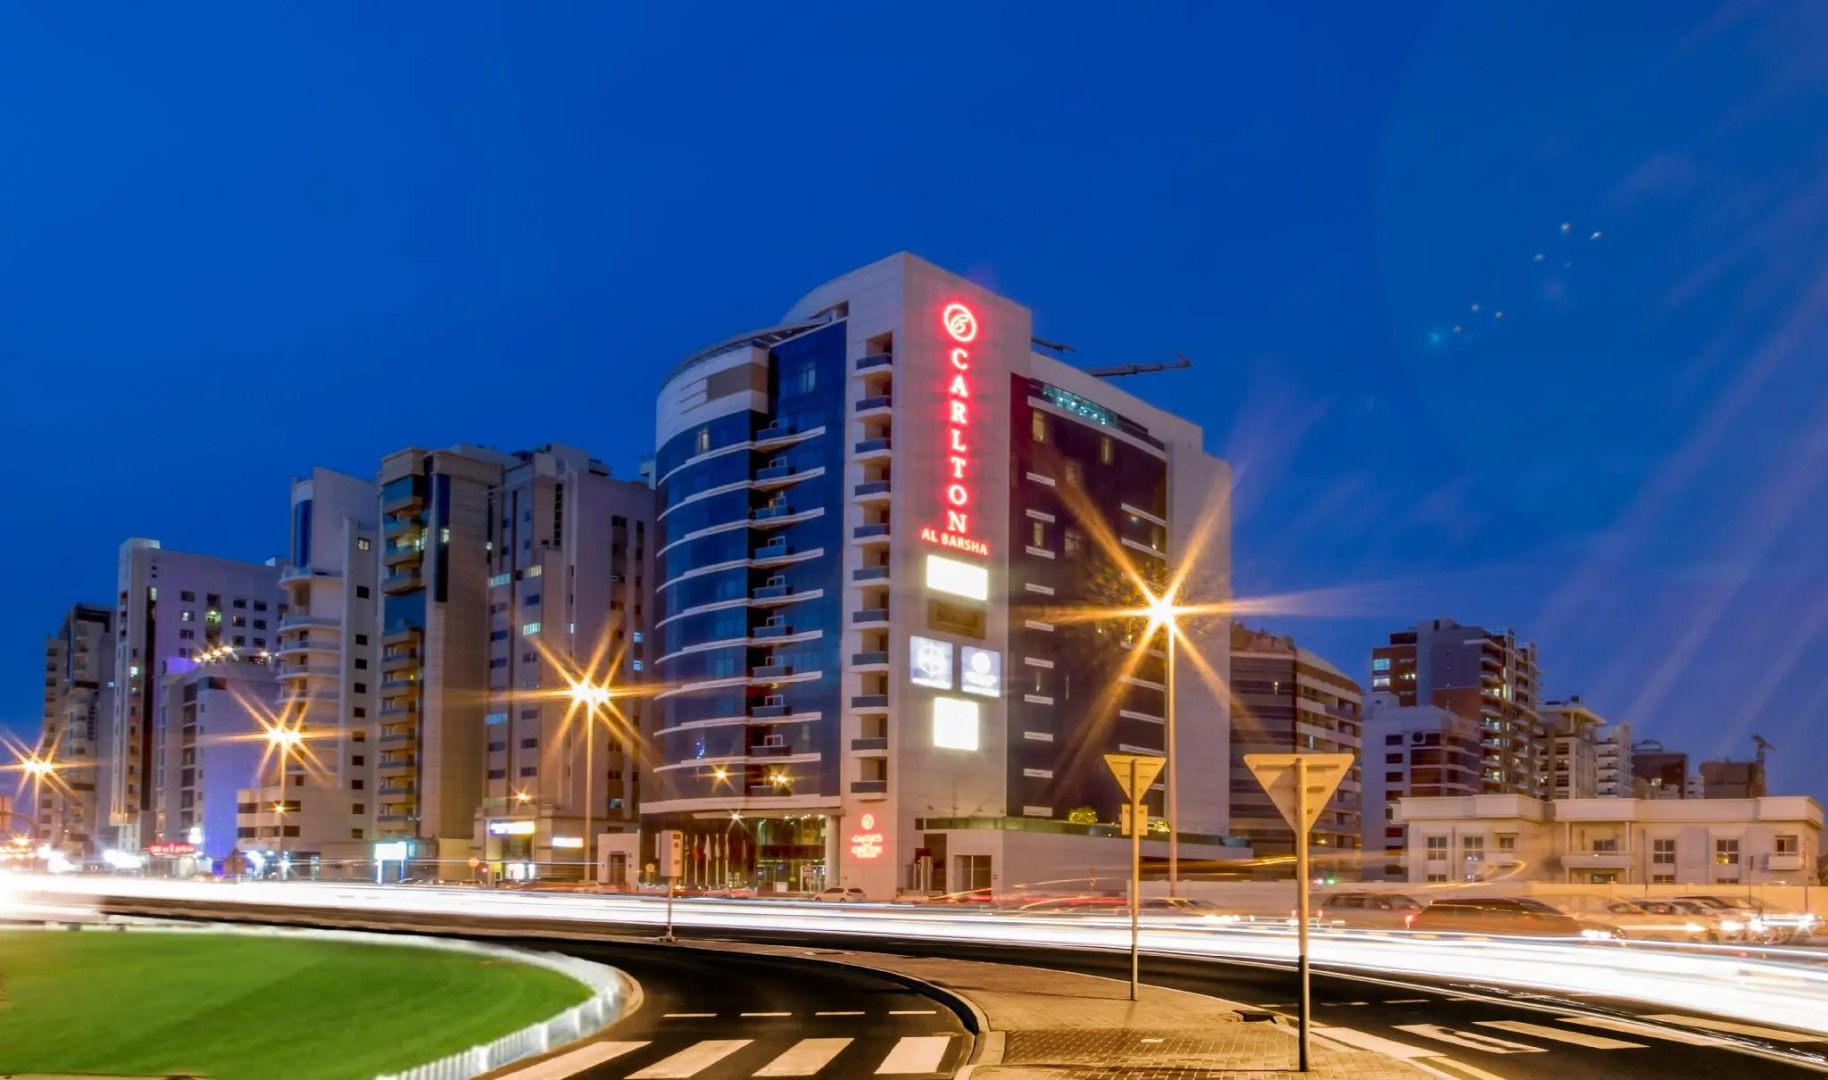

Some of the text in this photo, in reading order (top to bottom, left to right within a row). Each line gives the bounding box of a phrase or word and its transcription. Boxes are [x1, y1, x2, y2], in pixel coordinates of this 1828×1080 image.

[948, 348, 969, 533] CARLTON
[921, 528, 988, 556] AL BARSHA
